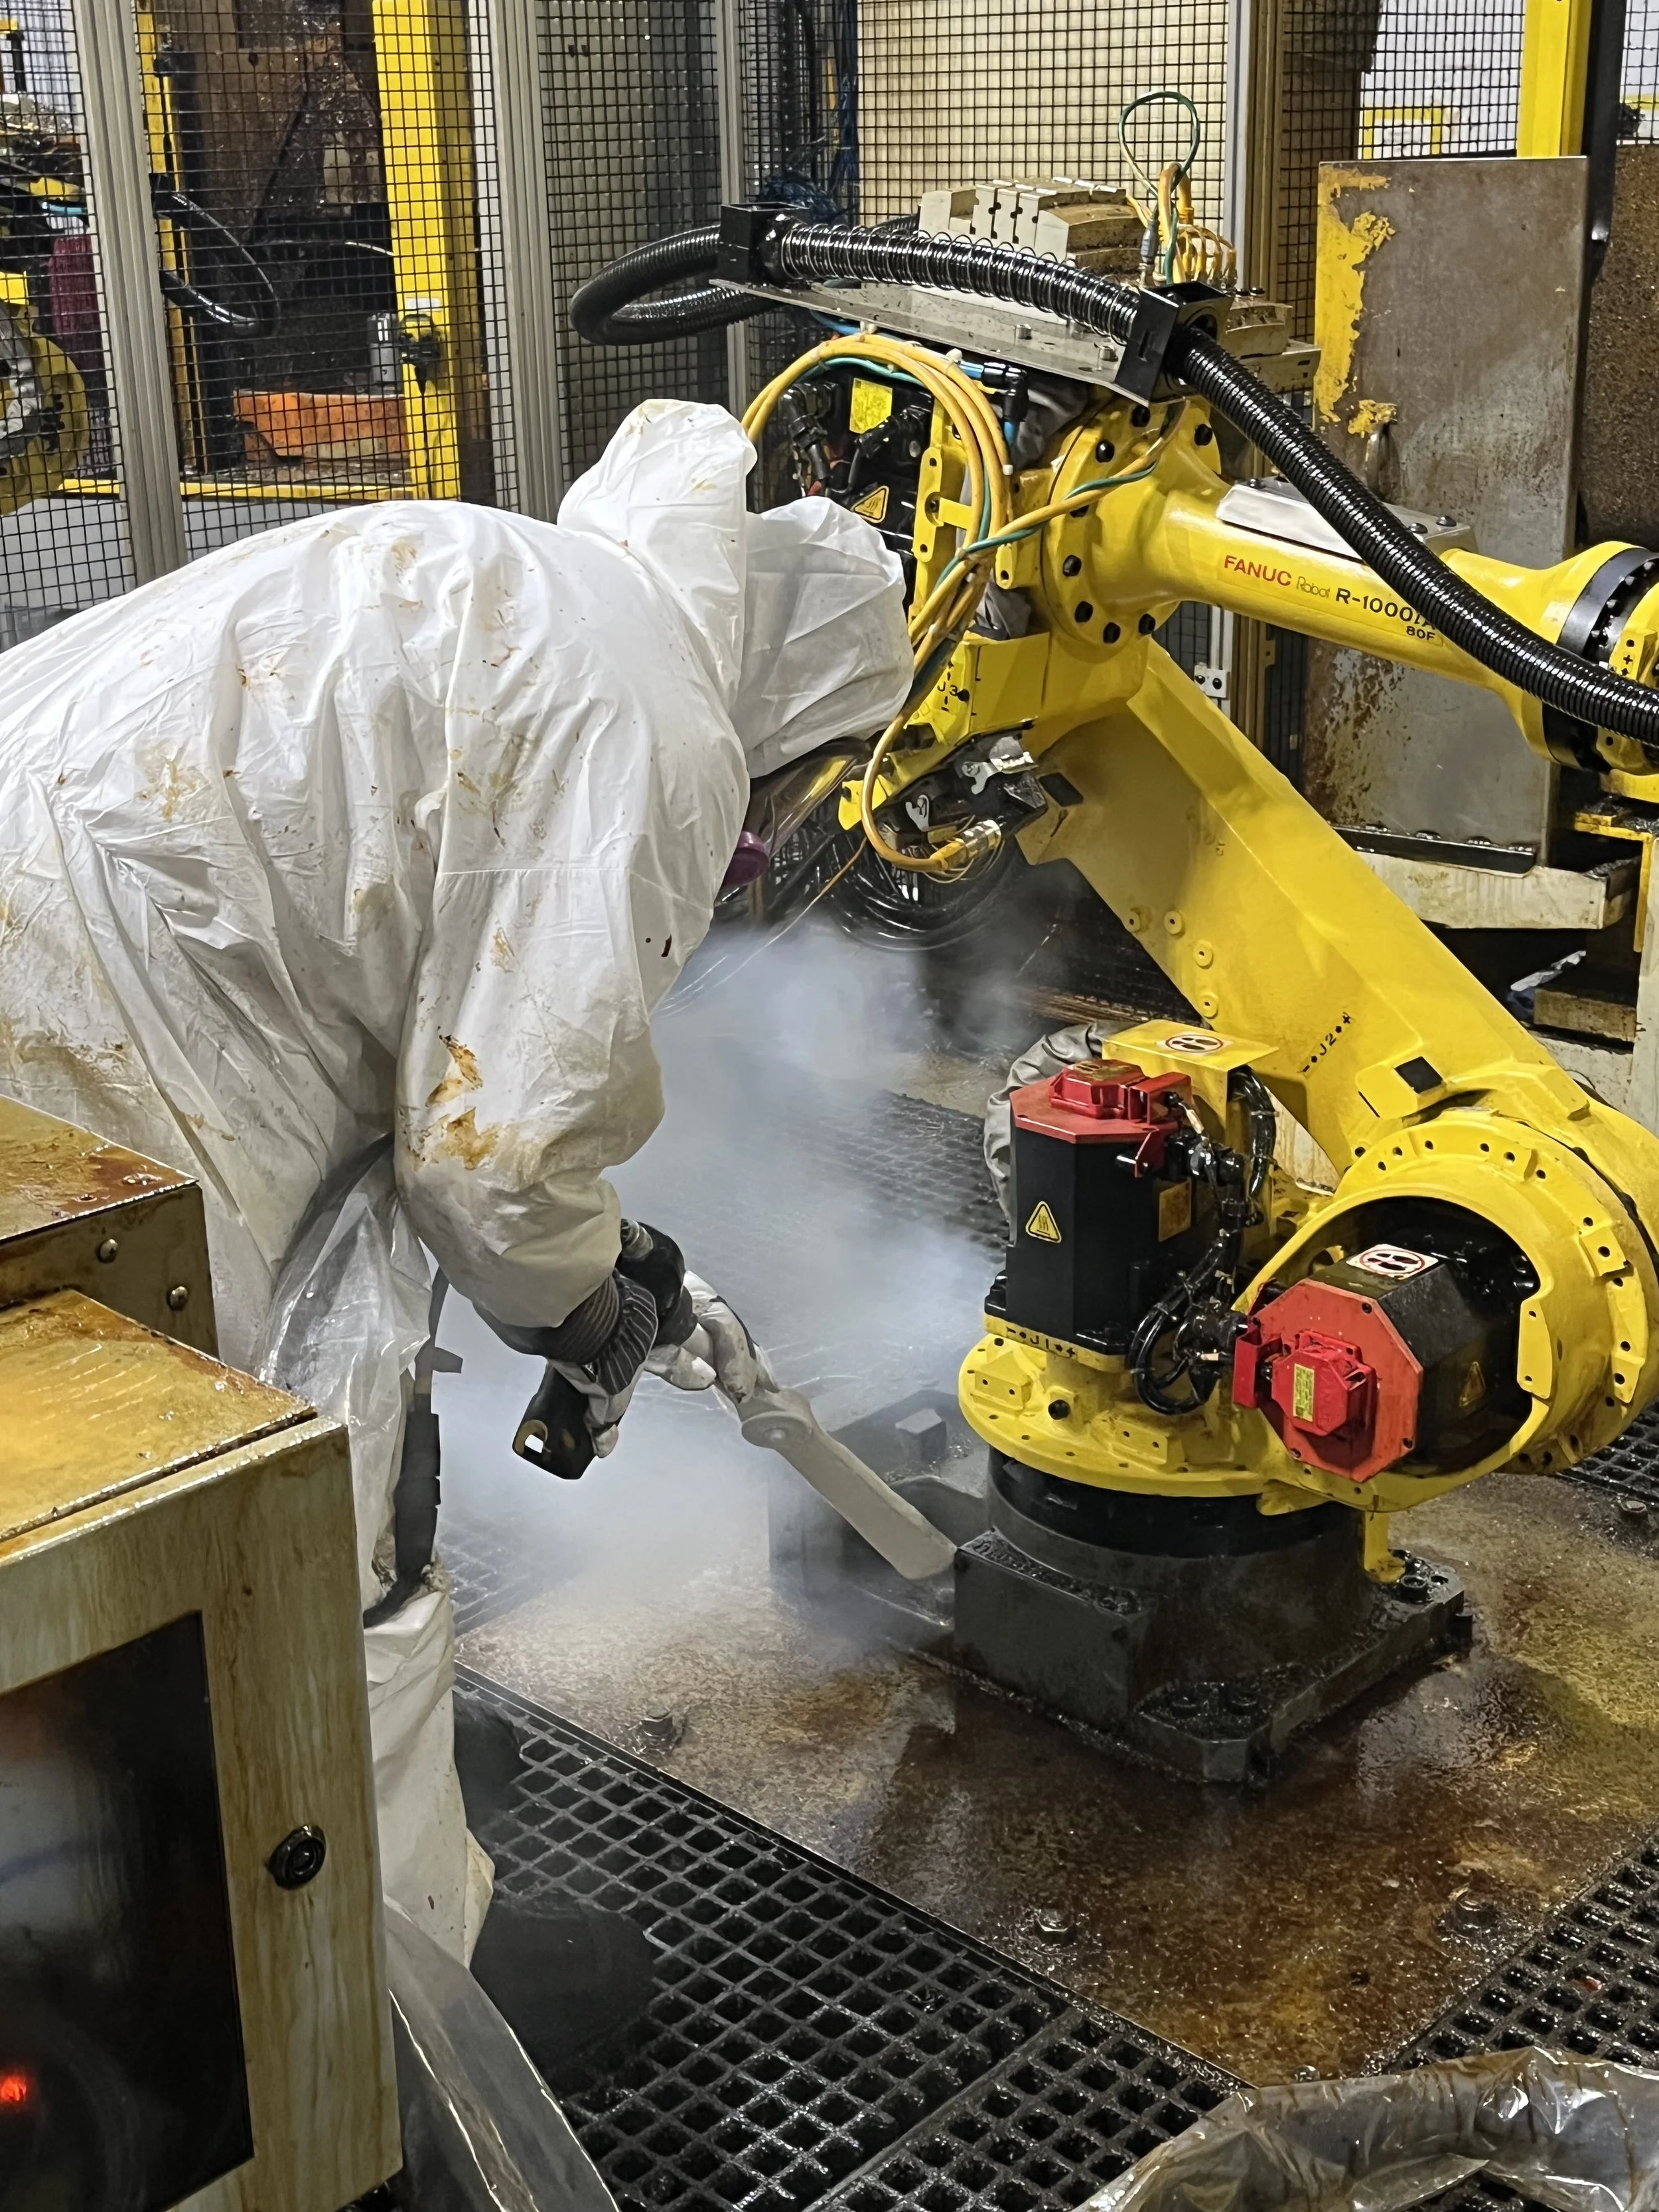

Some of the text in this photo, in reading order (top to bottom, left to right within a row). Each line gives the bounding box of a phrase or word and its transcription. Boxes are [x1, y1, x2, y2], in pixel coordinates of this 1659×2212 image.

[1224, 555, 1292, 586] FANUC
[1296, 576, 1331, 599] Robot
[1406, 626, 1435, 640] 80F
[937, 681, 958, 697] J3
[1319, 1033, 1336, 1056] J2
[1030, 1335, 1049, 1351] J1
